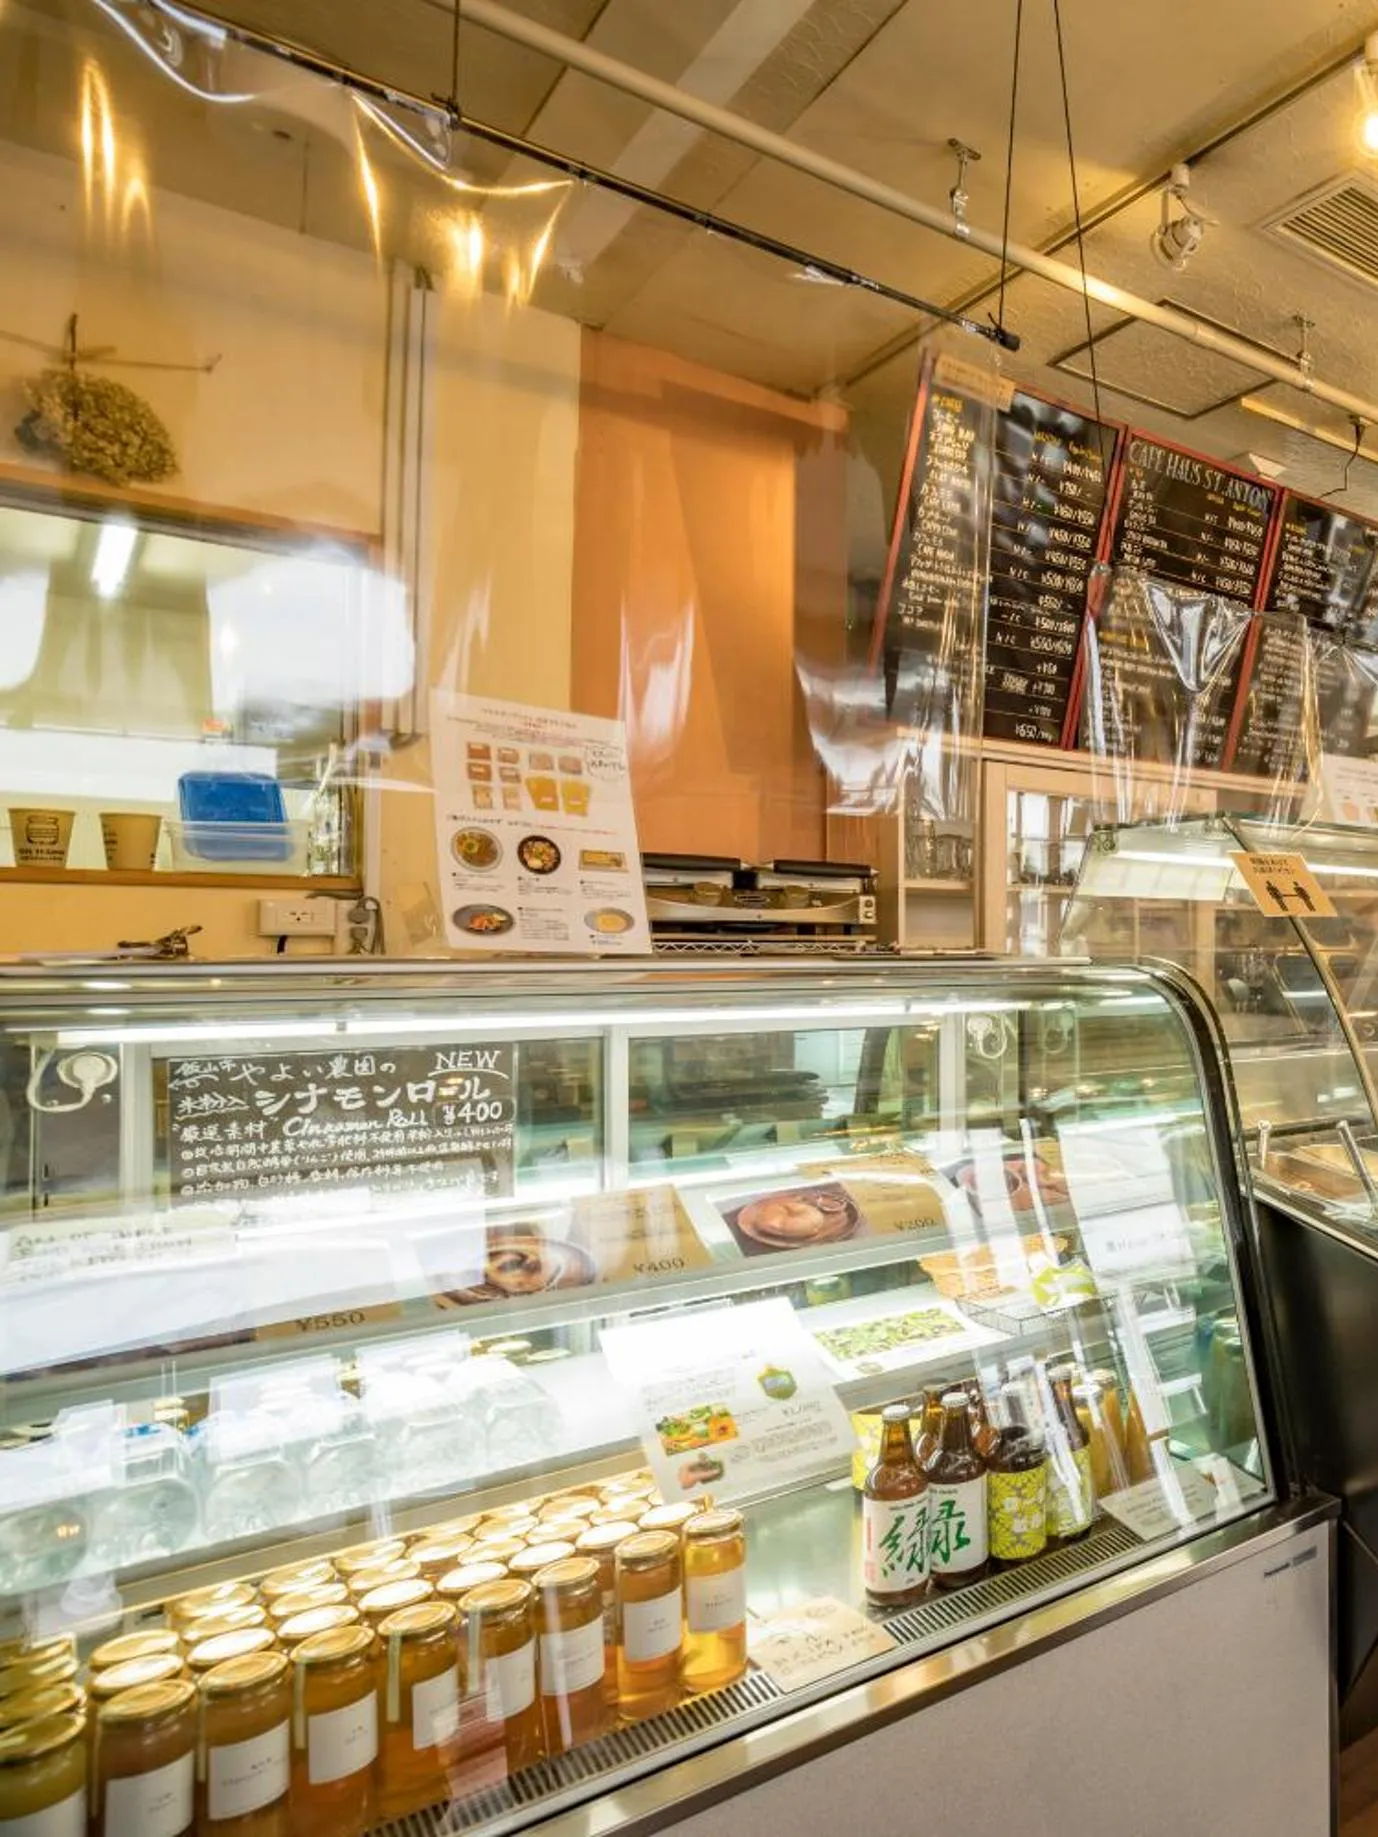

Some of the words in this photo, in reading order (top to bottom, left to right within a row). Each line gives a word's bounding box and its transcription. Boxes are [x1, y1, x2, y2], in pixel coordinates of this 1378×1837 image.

[1129, 440, 1165, 473] CAFE
[1166, 452, 1202, 486] HAUS
[435, 1050, 501, 1071] NEW
[254, 1076, 491, 1116] シナモンロール
[387, 1108, 428, 1128] Roll
[443, 1101, 503, 1126] ¥400
